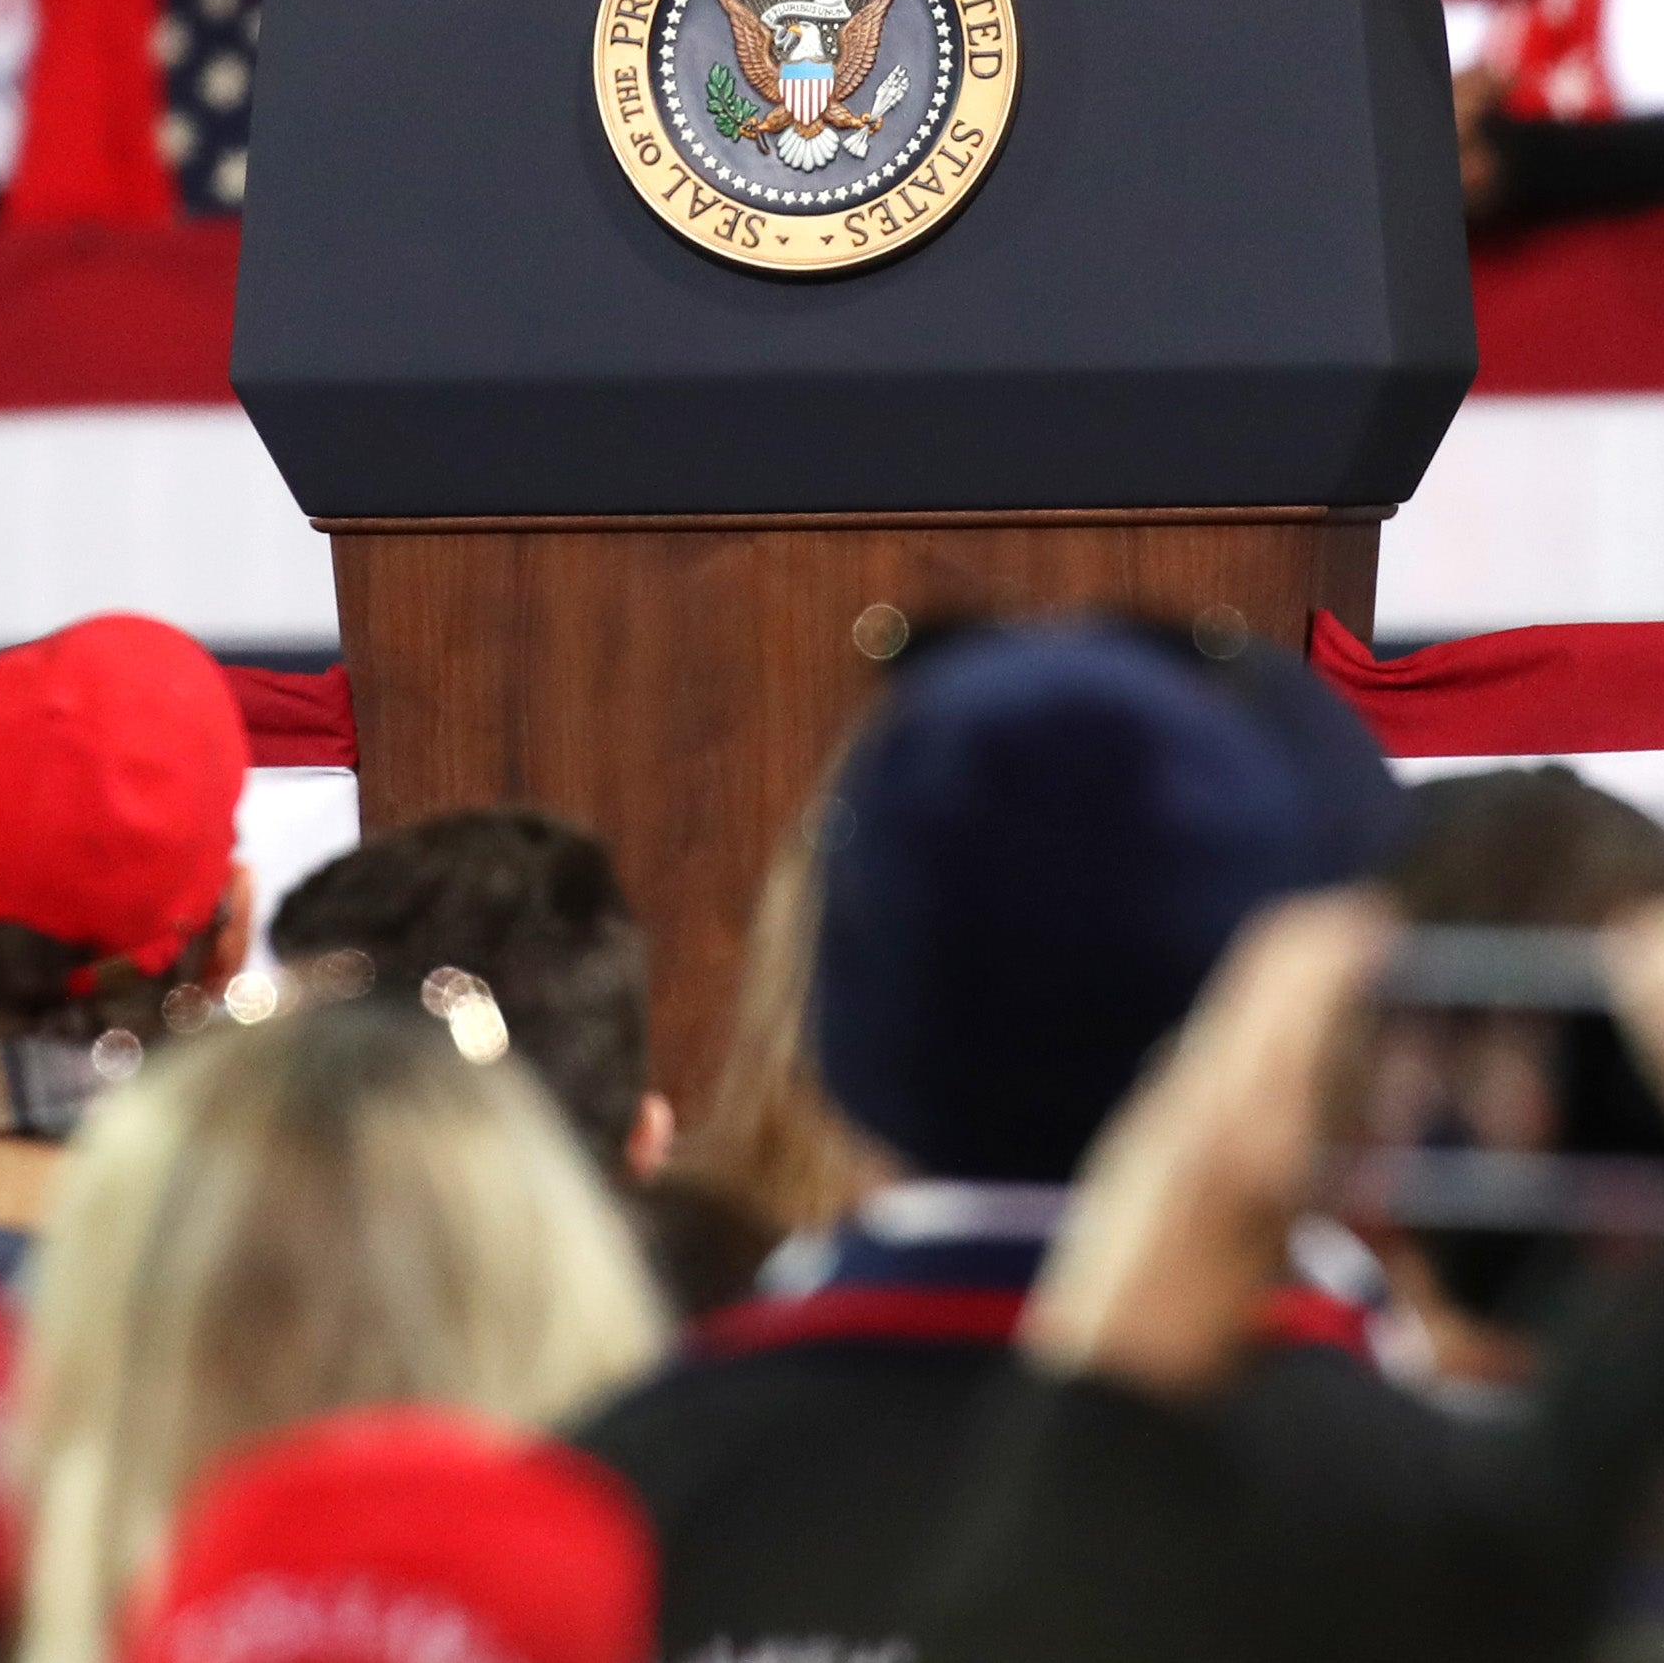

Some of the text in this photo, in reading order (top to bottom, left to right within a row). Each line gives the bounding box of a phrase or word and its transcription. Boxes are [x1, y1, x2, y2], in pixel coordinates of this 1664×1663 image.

[772, 4, 817, 17] PLURIBUS
[818, 6, 847, 17] UNUM
[615, 65, 644, 124] THE
[631, 132, 662, 166] OF
[661, 164, 766, 249] SEAL
[844, 120, 985, 247] STATES
